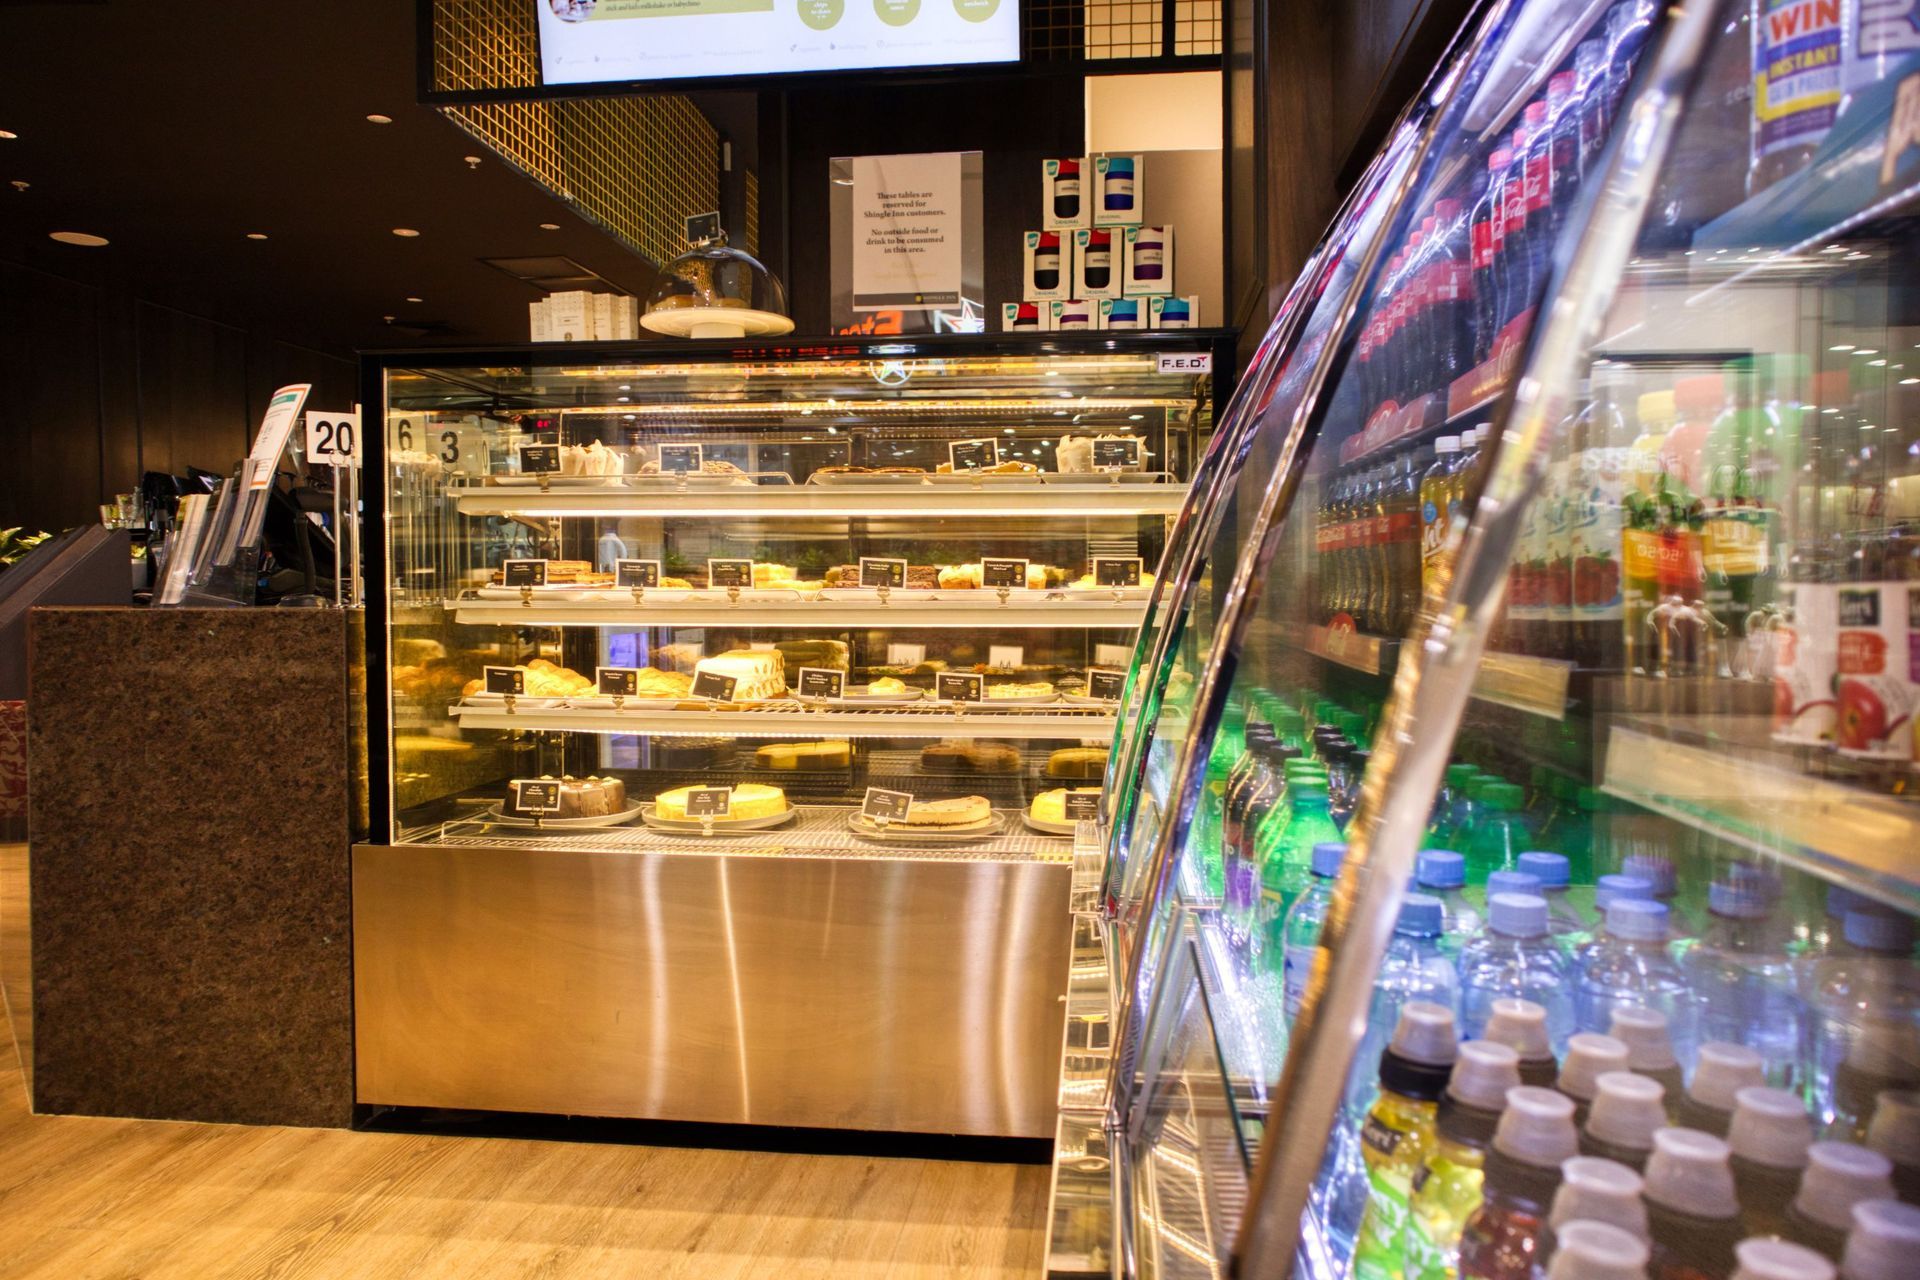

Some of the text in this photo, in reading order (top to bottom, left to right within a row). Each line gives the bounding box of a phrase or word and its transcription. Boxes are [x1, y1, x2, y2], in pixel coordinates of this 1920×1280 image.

[1770, 0, 1840, 42] WIN
[1768, 44, 1838, 80] INSTANT
[877, 192, 898, 200] These
[898, 190, 920, 199] tables
[882, 199, 927, 209] reserved for
[863, 210, 891, 219] Shingle
[906, 209, 946, 217] customers.
[911, 227, 929, 235] food
[866, 237, 886, 245] drink
[1162, 359, 1205, 368] F.E.D.
[315, 420, 354, 456] 20
[398, 419, 413, 451] 6
[441, 431, 459, 463] 3
